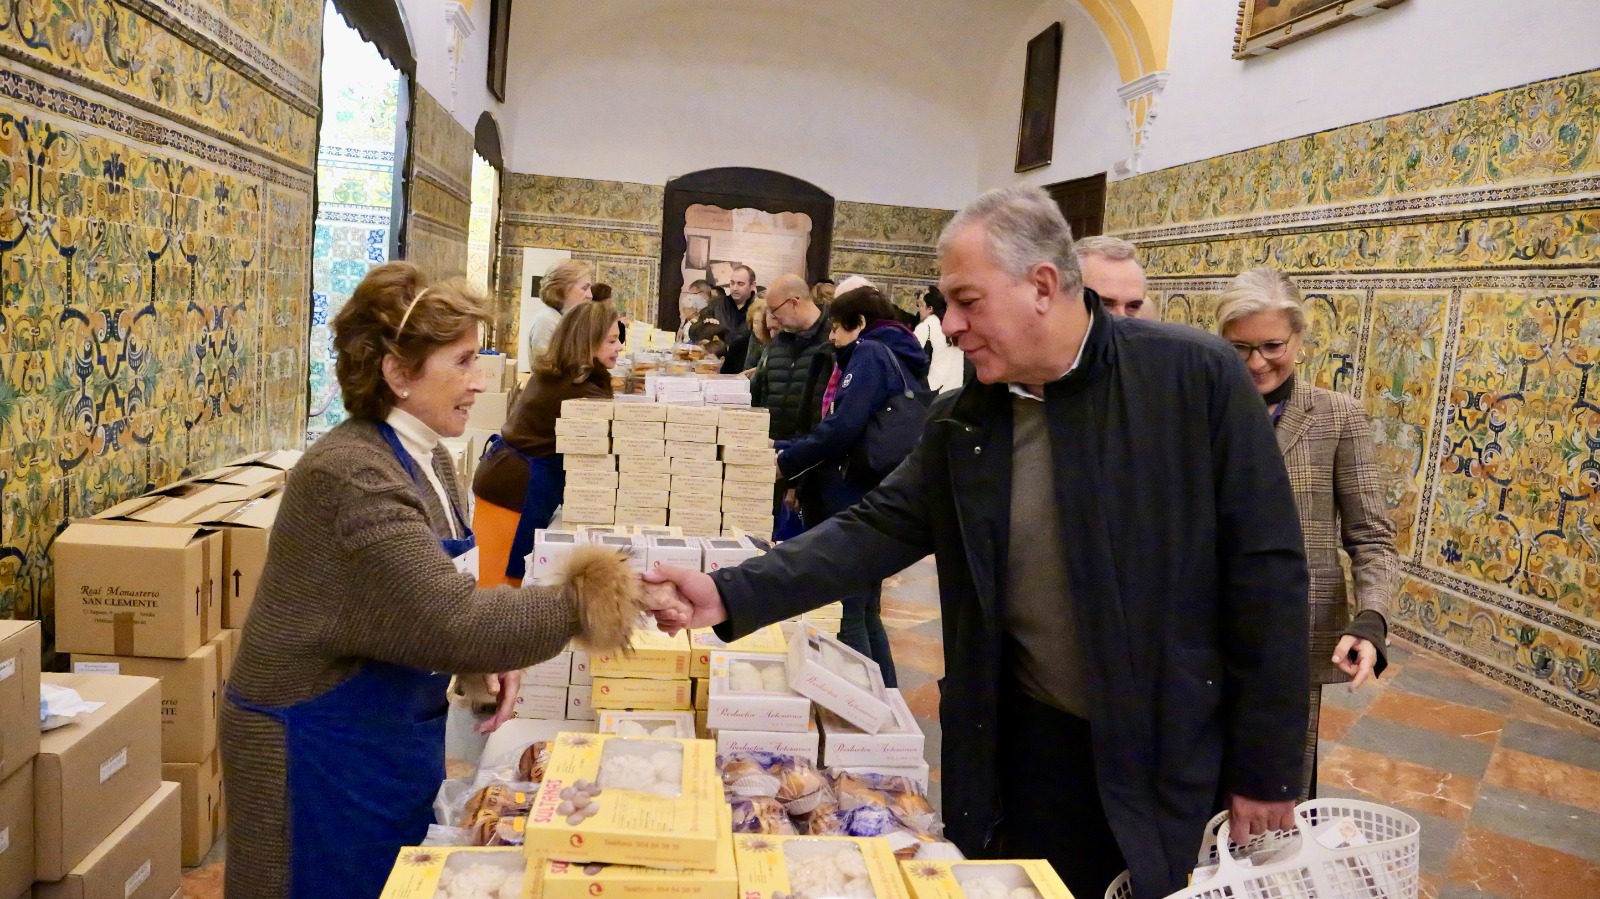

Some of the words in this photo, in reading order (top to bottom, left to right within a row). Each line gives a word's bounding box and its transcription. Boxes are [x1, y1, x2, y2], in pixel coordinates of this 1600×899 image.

[80, 585, 102, 597] Real
[106, 586, 160, 598] Monasterio
[82, 597, 102, 606] SAN
[104, 598, 159, 608] CLEMENTE
